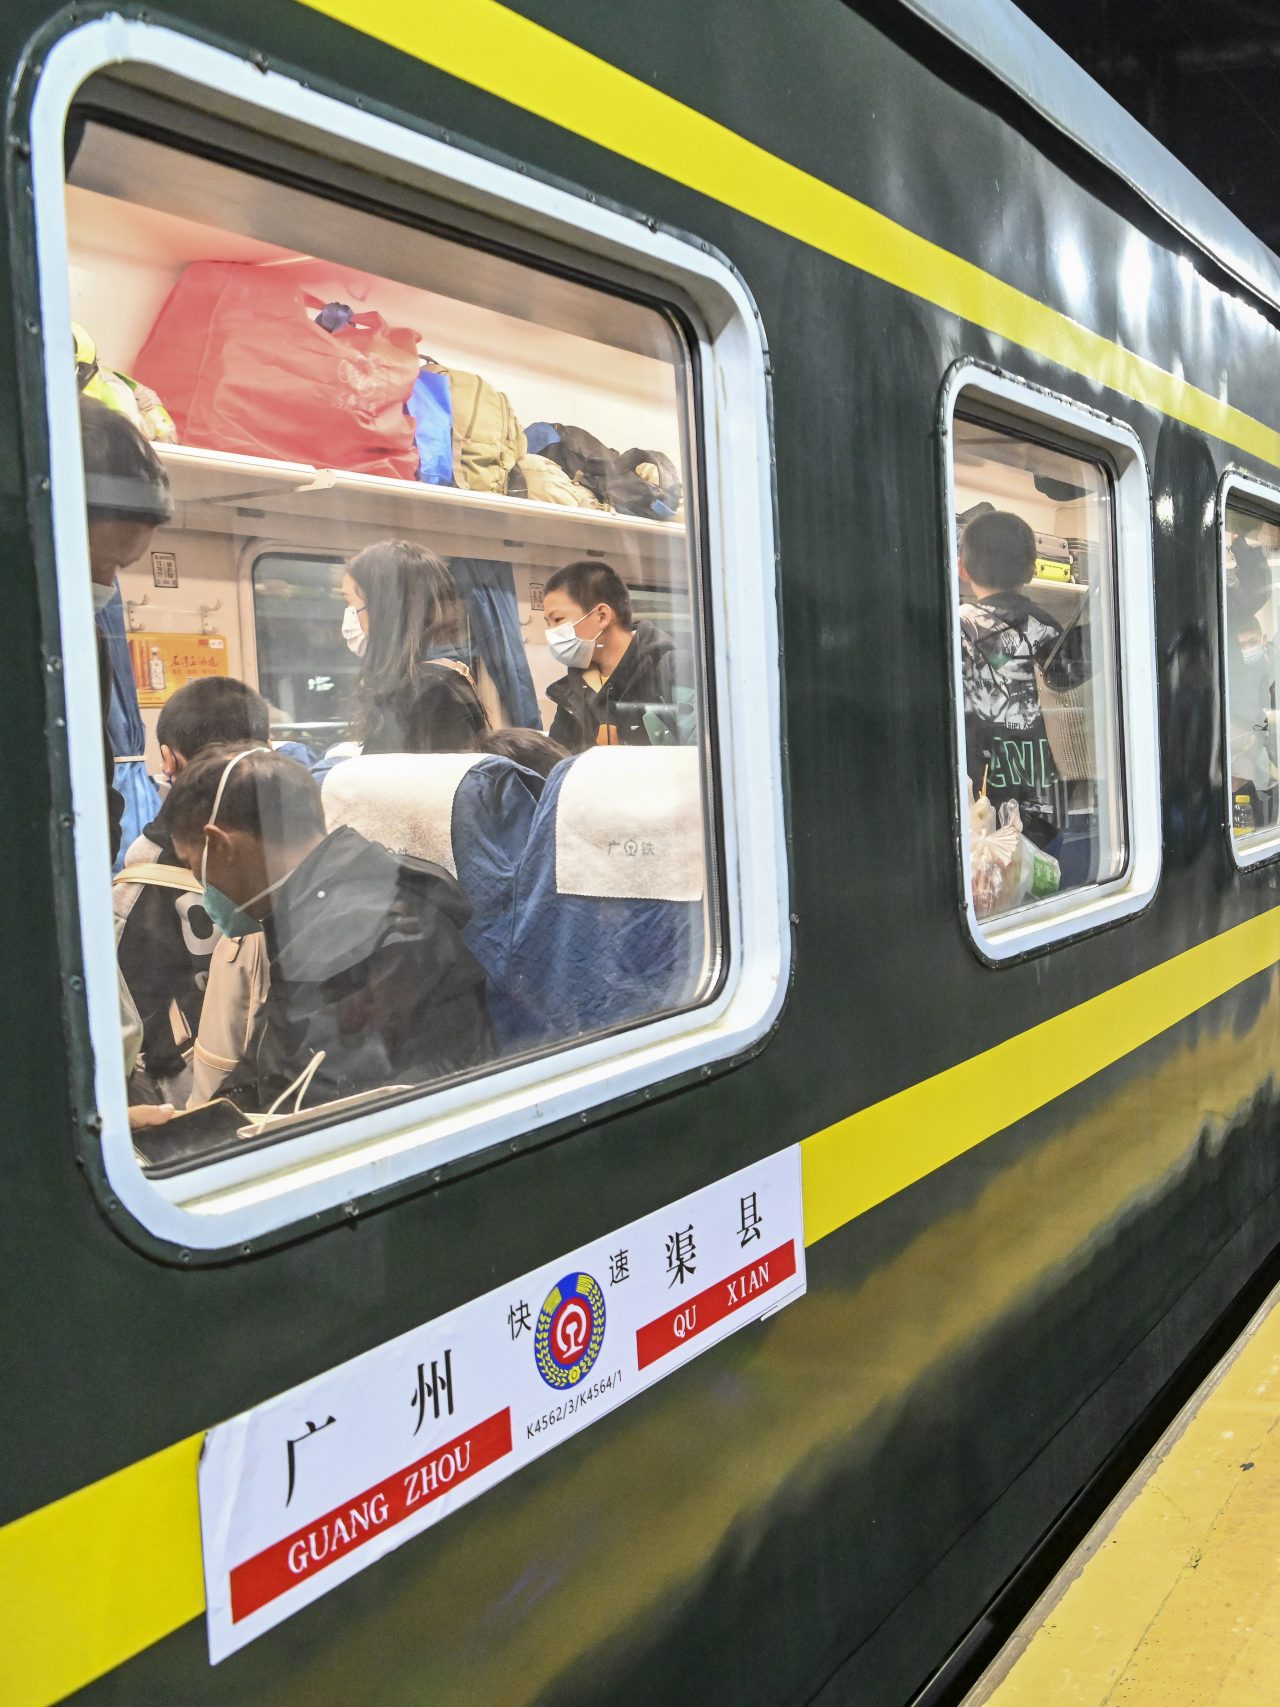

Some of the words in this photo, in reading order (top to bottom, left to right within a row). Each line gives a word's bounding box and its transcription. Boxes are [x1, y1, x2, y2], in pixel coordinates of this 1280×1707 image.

[665, 1191, 763, 1289] 渠县
[673, 1305, 698, 1339] QU
[726, 1262, 770, 1306] XIAN
[285, 1348, 455, 1509] 广州
[526, 1369, 622, 1440] K4562/3/K4564/1
[286, 1492, 390, 1574] GUANG
[402, 1440, 472, 1507] ZHOU
